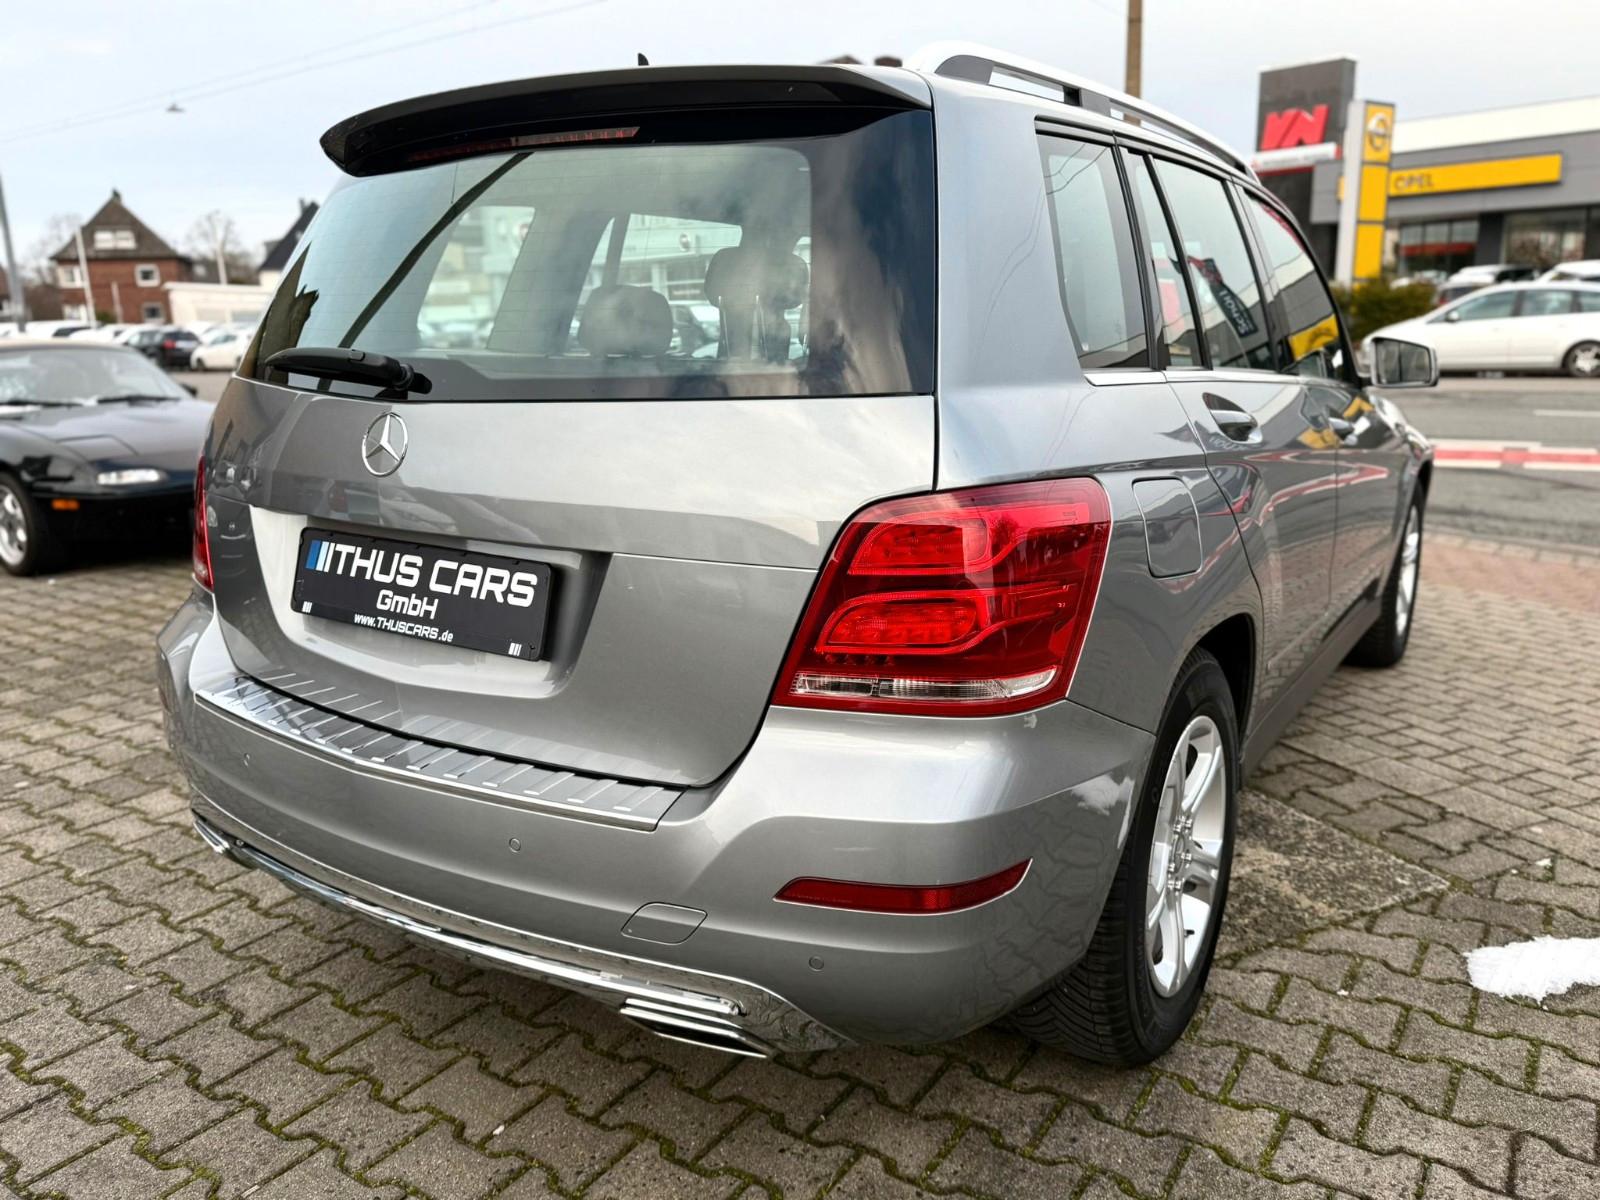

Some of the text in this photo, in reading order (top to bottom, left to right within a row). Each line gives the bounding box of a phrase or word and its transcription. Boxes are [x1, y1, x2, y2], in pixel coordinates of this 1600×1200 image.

[1394, 173, 1434, 191] OPEL
[429, 559, 538, 608] CARS
[376, 589, 439, 620] GmbH
[354, 613, 454, 643] www.THUSCARS.de
